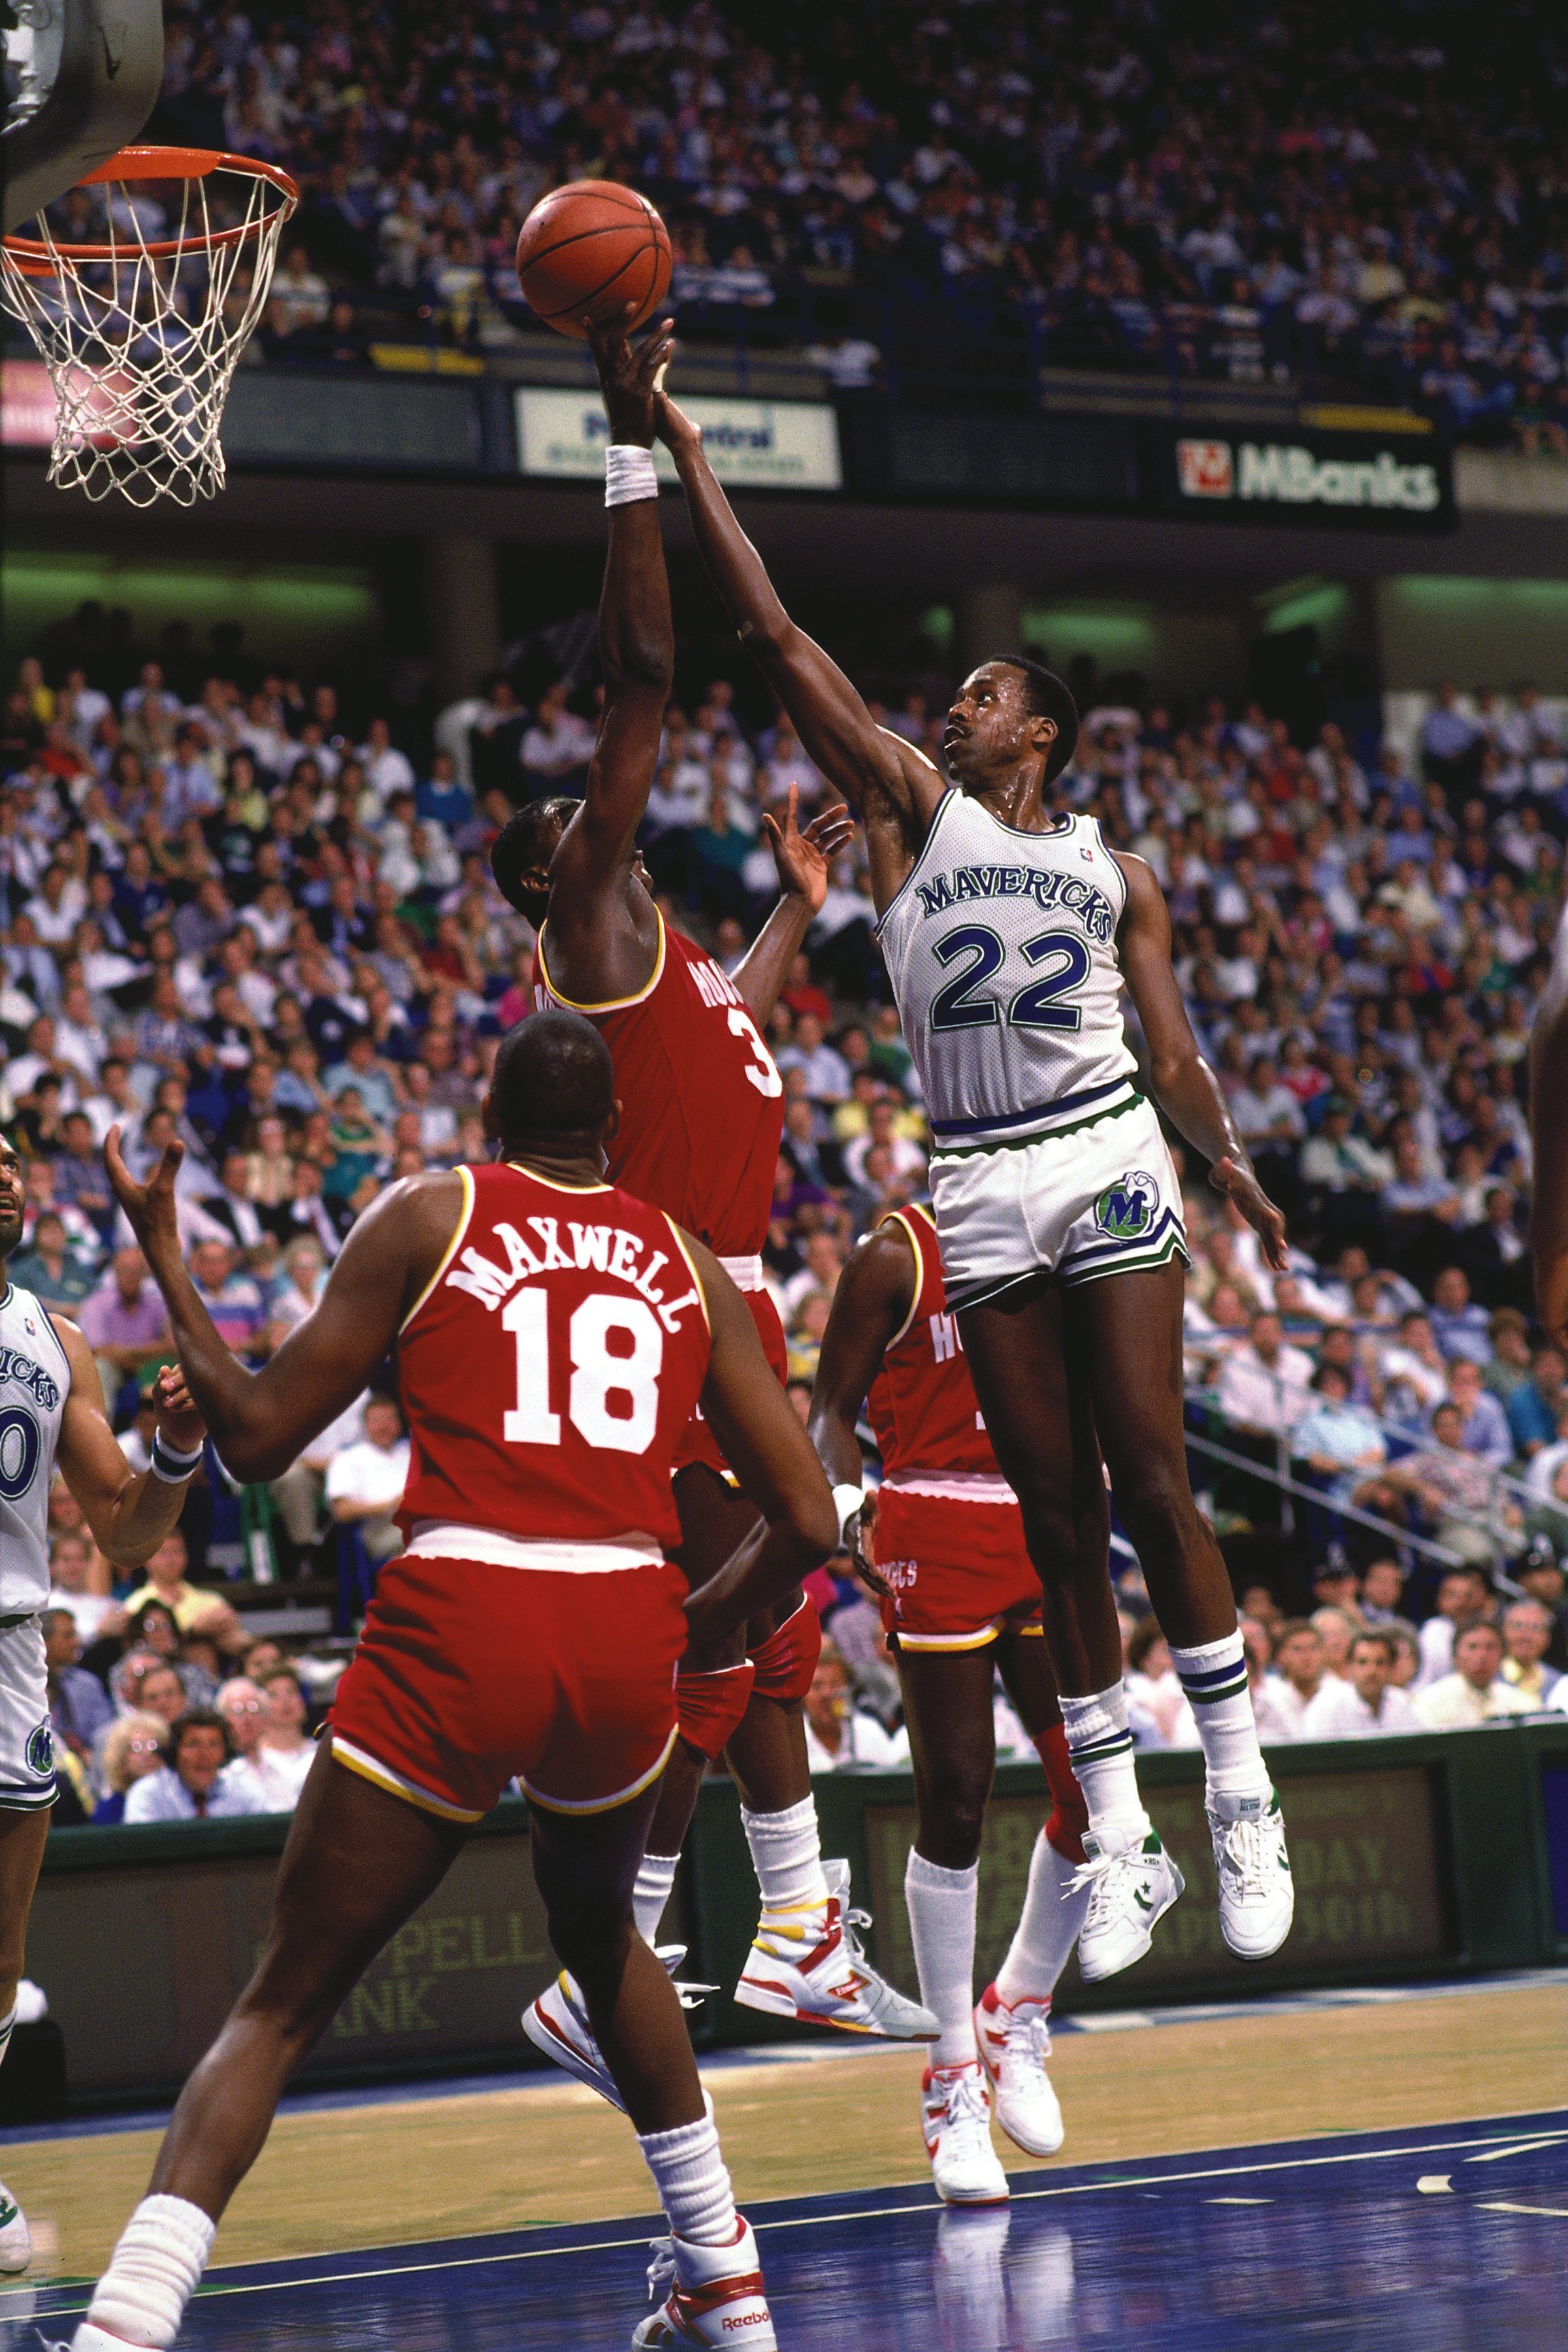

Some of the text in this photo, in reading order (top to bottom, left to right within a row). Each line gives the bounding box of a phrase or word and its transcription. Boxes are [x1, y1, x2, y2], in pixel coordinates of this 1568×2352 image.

[916, 864, 1113, 944] MAVERICKS
[687, 958, 743, 1007] HOU
[931, 923, 1091, 1032] 22
[446, 1217, 700, 1333] MAXWELL
[0, 1346, 59, 1411] ICKS
[502, 1287, 662, 1455] 18
[721, 2309, 770, 2331] Reebo
